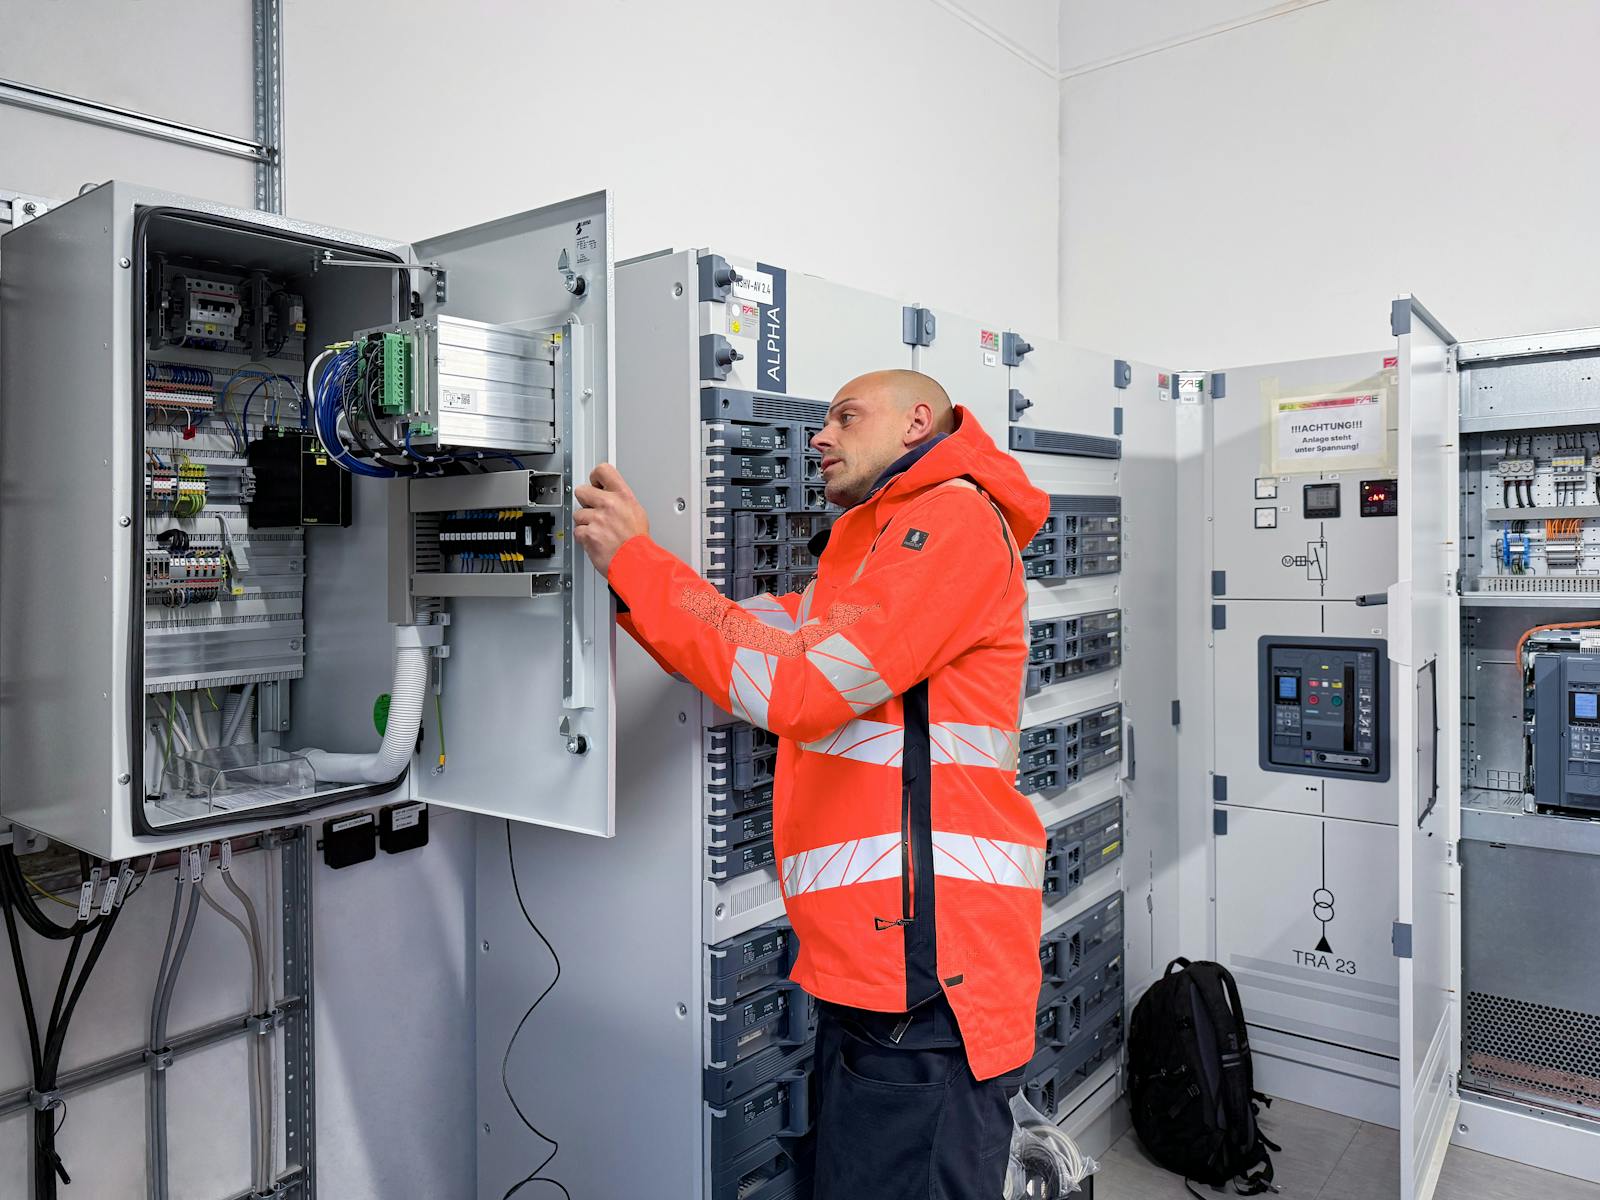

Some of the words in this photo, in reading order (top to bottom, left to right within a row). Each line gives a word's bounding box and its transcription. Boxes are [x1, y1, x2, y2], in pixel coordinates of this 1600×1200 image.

[762, 282, 771, 294] 2.4
[767, 307, 780, 382] ALPHA
[1291, 421, 1362, 433] !!!ACHTUNG!!!
[1302, 436, 1330, 444] Anlage
[1330, 434, 1352, 442] steht
[1316, 443, 1359, 452] Spannung!
[1292, 949, 1330, 970] TRA
[1335, 958, 1356, 975] 23
